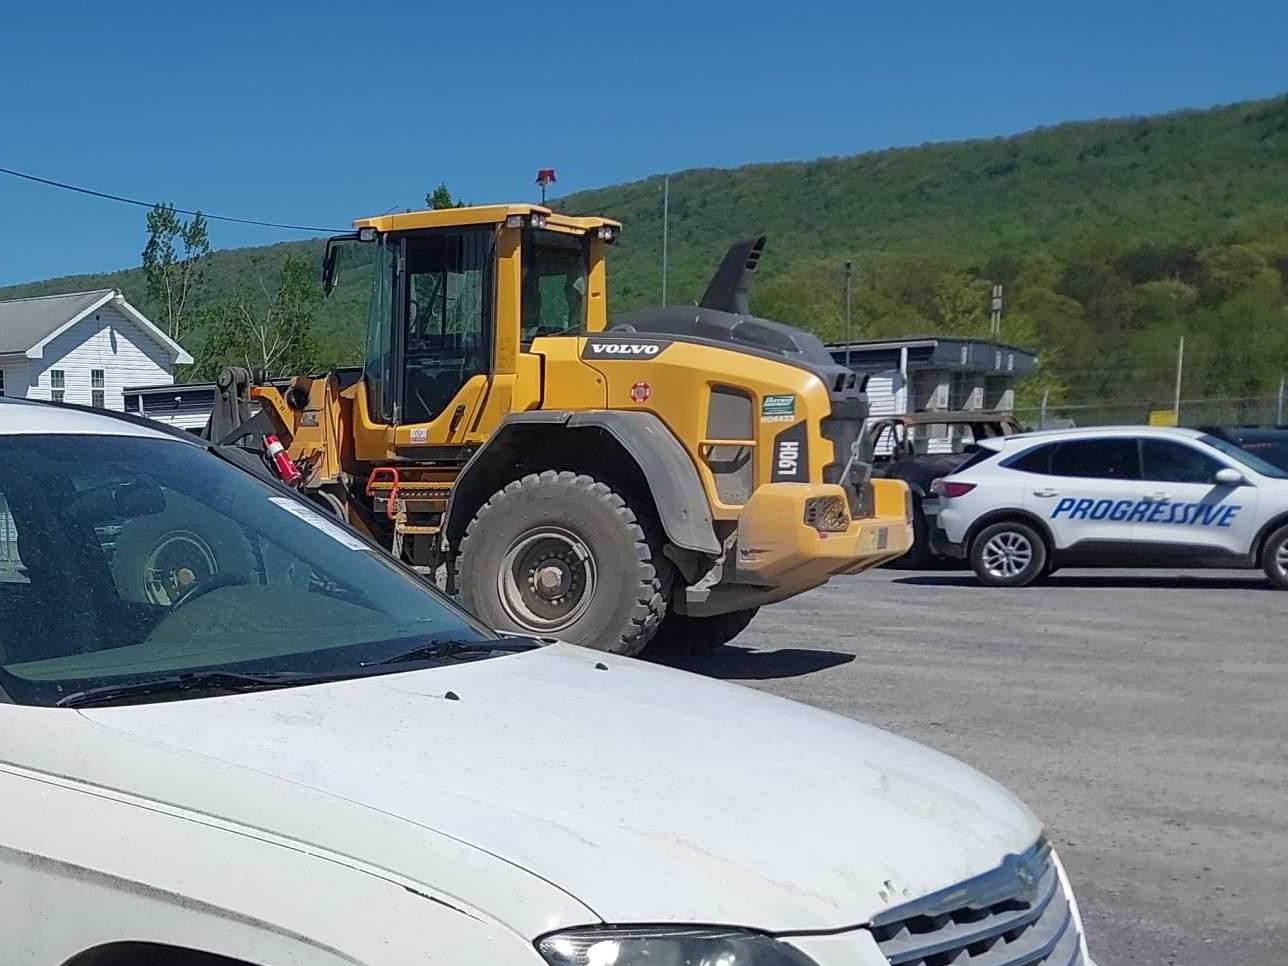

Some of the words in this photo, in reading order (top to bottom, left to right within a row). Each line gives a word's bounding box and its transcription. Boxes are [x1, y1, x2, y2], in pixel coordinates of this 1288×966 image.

[591, 344, 659, 354] VOLVO
[777, 441, 799, 475] L90H
[1050, 498, 1242, 528] PROGRESSIVE
